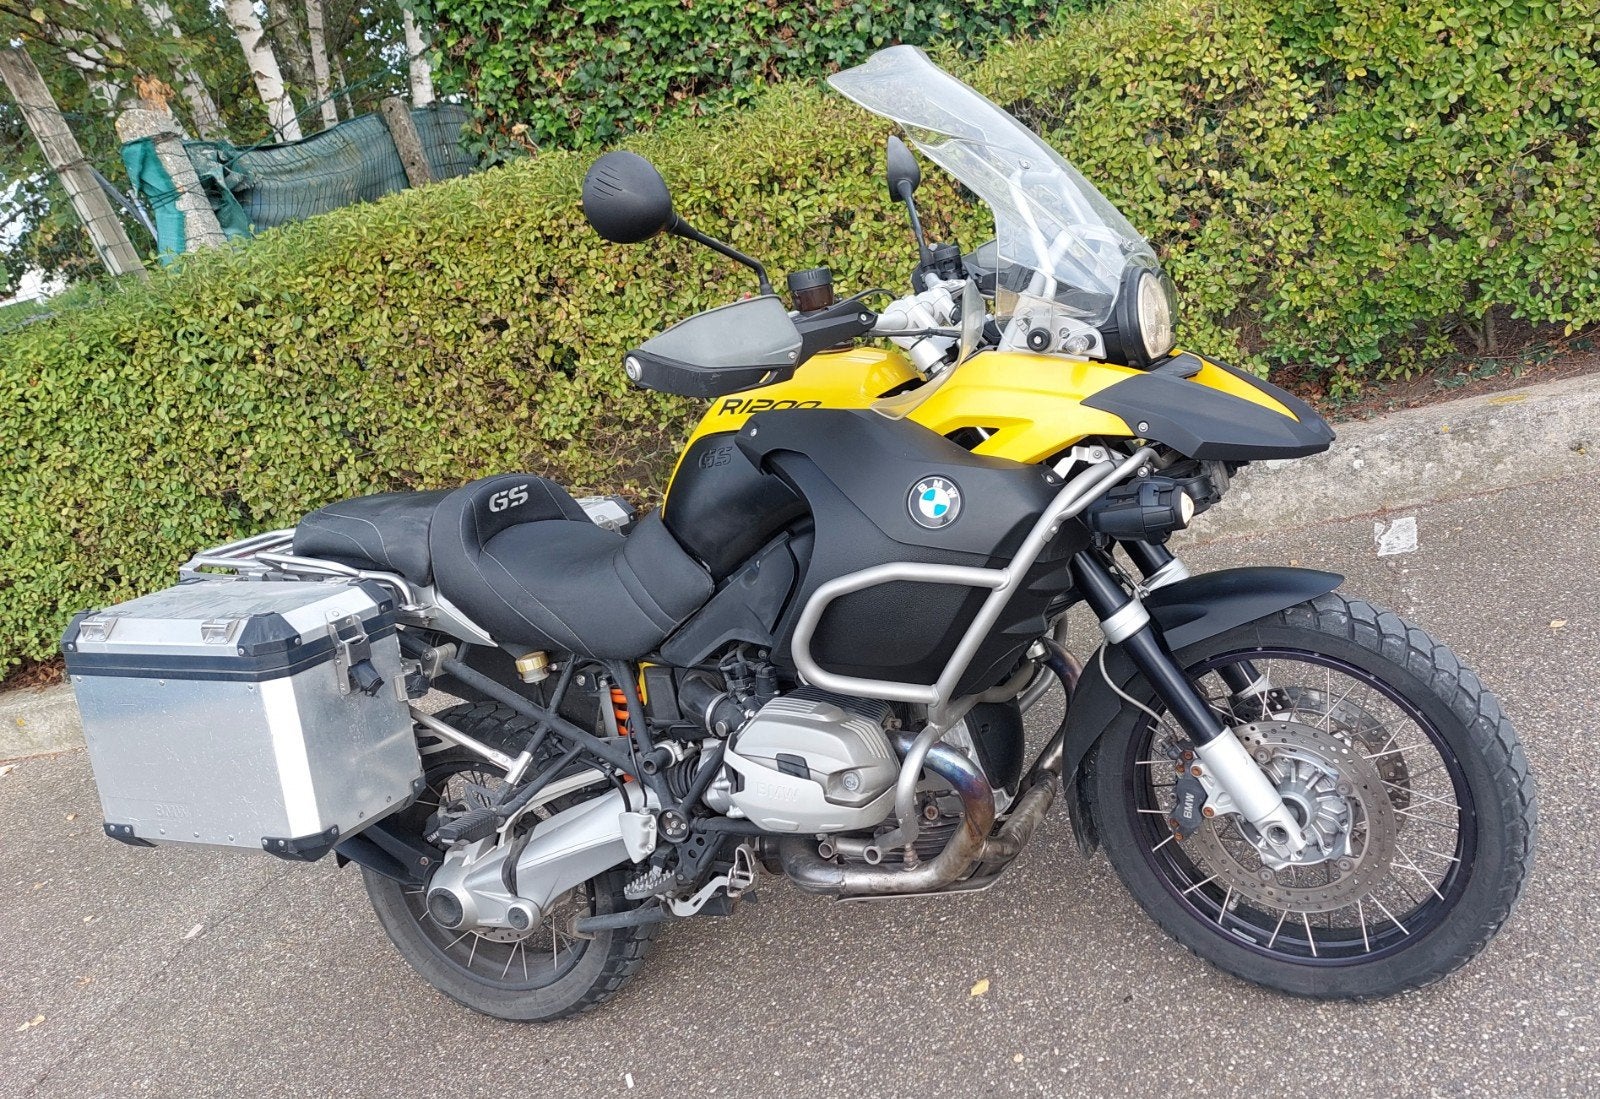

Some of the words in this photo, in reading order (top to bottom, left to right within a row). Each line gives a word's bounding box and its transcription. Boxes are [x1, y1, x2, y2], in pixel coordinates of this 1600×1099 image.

[718, 399, 822, 416] R1200
[699, 446, 733, 469] GS
[489, 484, 529, 512] GS
[917, 479, 958, 499] BMW
[756, 782, 801, 801] BMW
[1183, 792, 1195, 819] BMW
